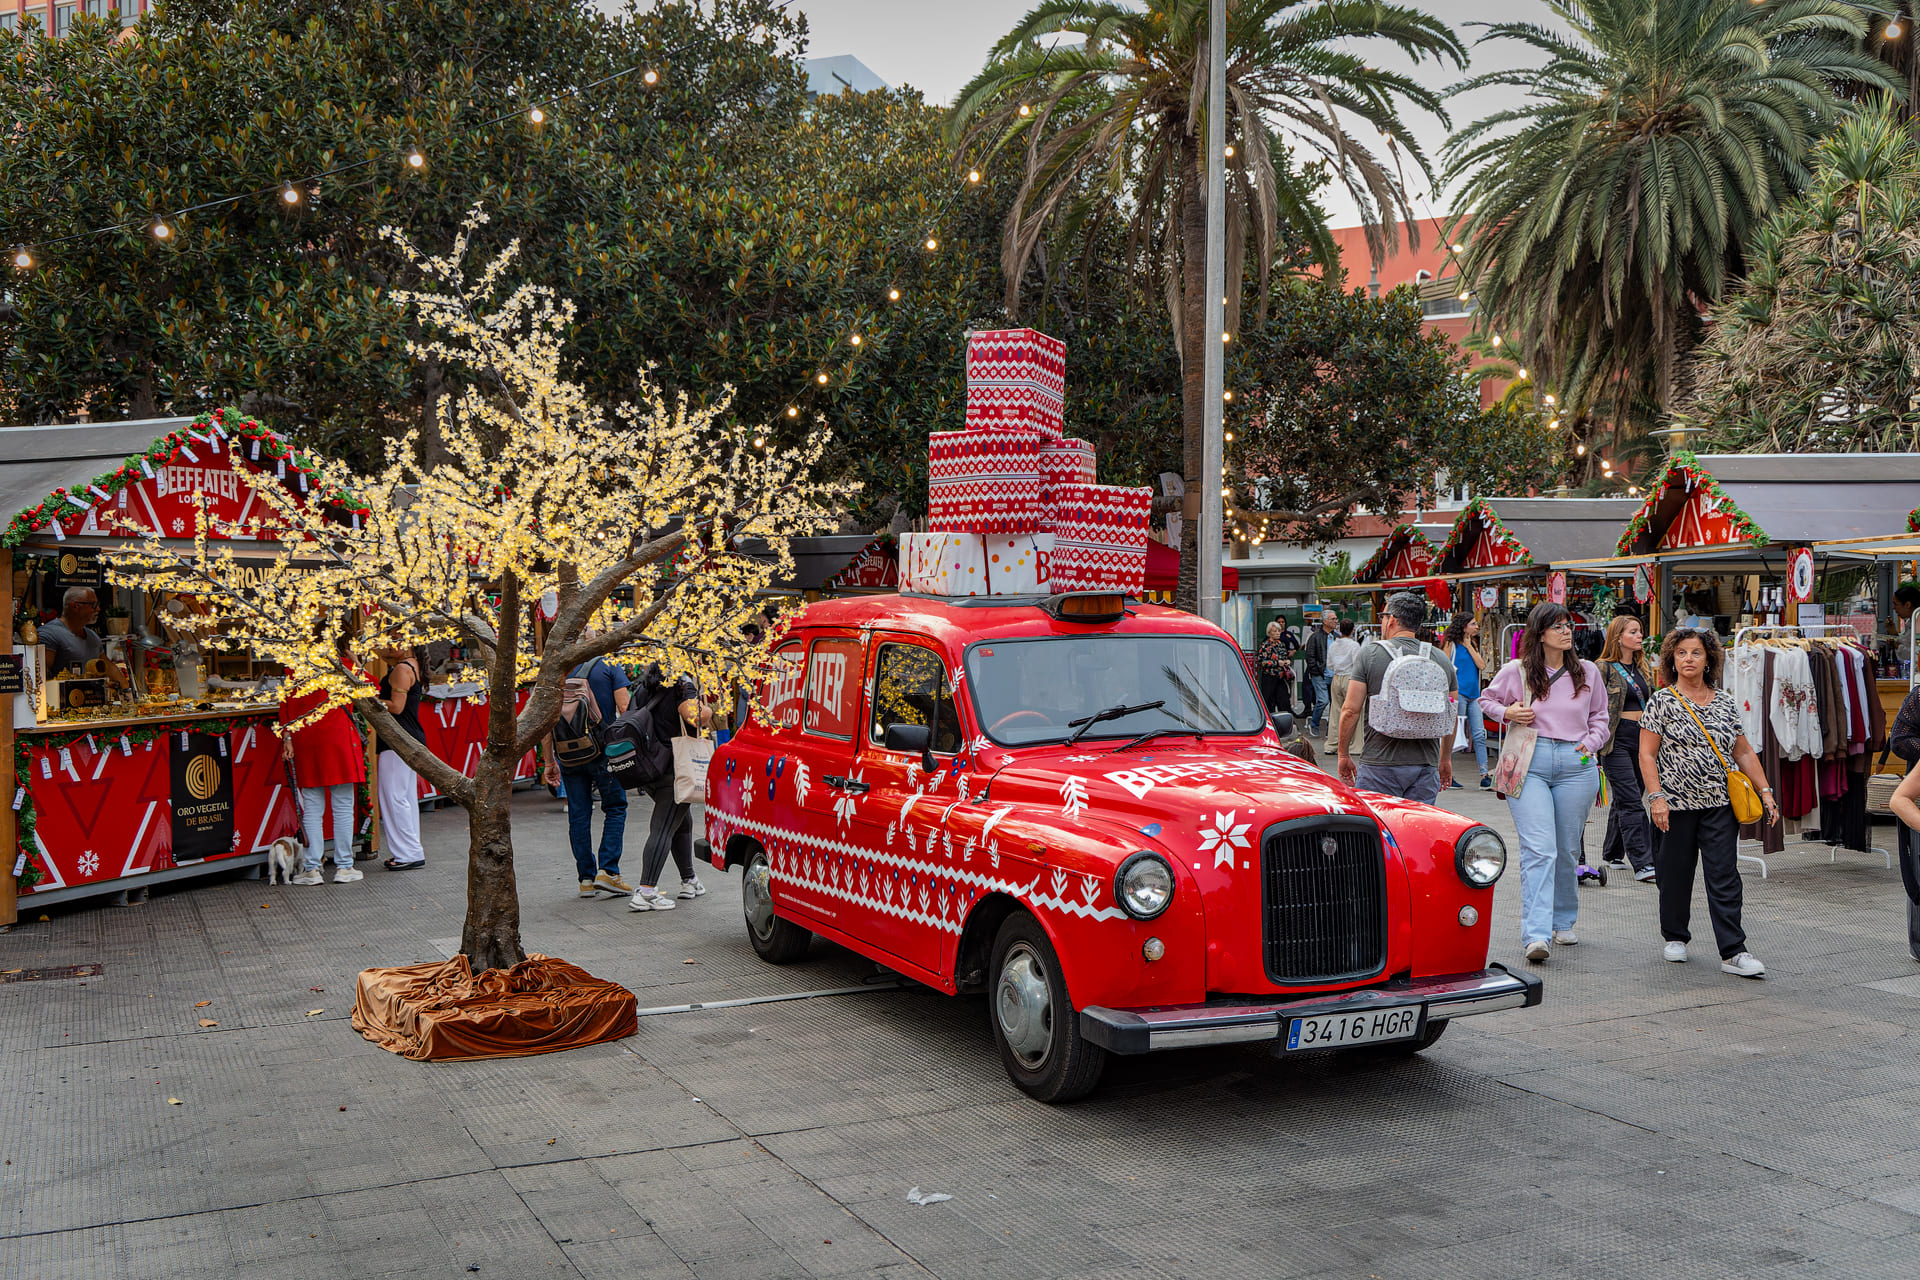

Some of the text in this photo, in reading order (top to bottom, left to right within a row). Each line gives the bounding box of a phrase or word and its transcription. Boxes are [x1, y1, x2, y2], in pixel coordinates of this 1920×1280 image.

[156, 465, 239, 503] BEEFEATER
[179, 494, 219, 505] LOON
[860, 556, 884, 571] EEFEATER
[1102, 759, 1330, 800] BEEFEATER
[1190, 769, 1294, 782] LONDON
[177, 801, 230, 817] ORO VEGETAL
[186, 813, 224, 827] DE BRASIL
[1303, 1010, 1415, 1044] 3416 HGR
